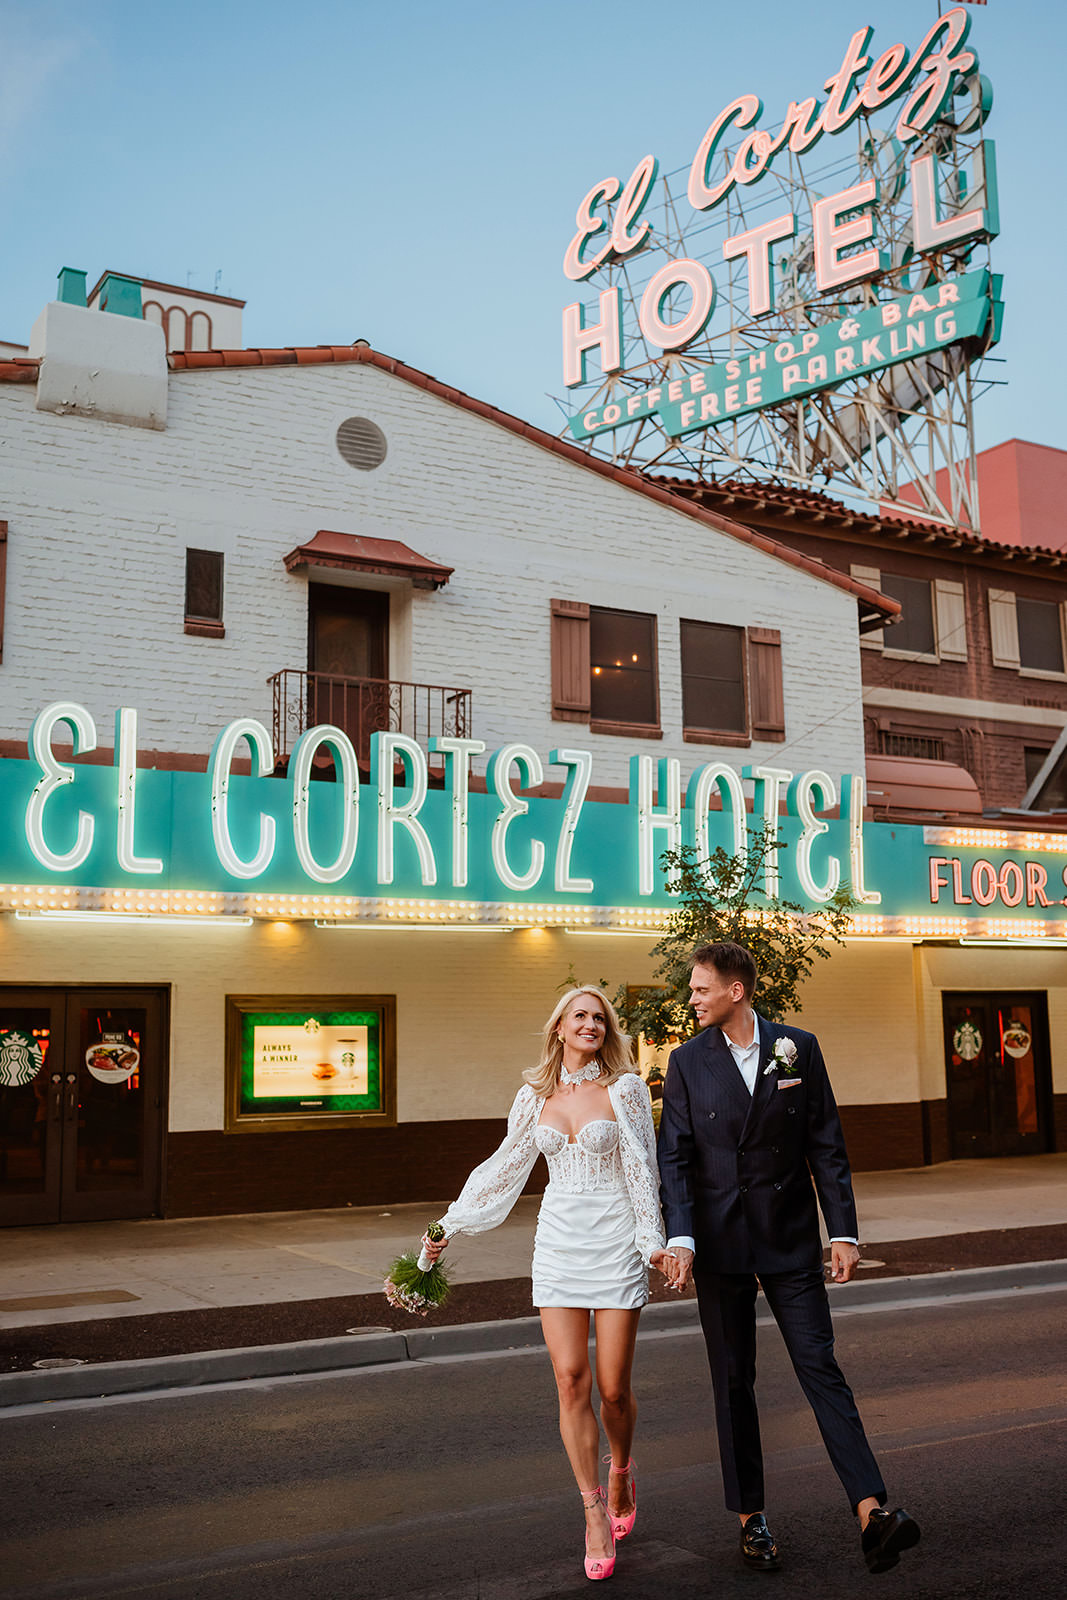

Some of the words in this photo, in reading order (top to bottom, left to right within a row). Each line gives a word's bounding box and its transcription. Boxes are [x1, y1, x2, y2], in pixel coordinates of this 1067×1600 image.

[563, 154, 657, 281] El
[688, 7, 977, 209] Cortez
[562, 154, 989, 388] HOTEL
[583, 374, 707, 431] COFFEE
[725, 332, 820, 381] SHOP
[838, 318, 861, 341] &
[881, 283, 961, 327] BAR
[681, 377, 763, 428] FREE
[782, 311, 958, 393] PARKING
[25, 701, 164, 874] EL
[208, 717, 594, 892] CORTEZ
[632, 755, 882, 905] HOTEL
[929, 856, 1049, 907] FLOOR
[263, 1044, 291, 1052] ALWAYS
